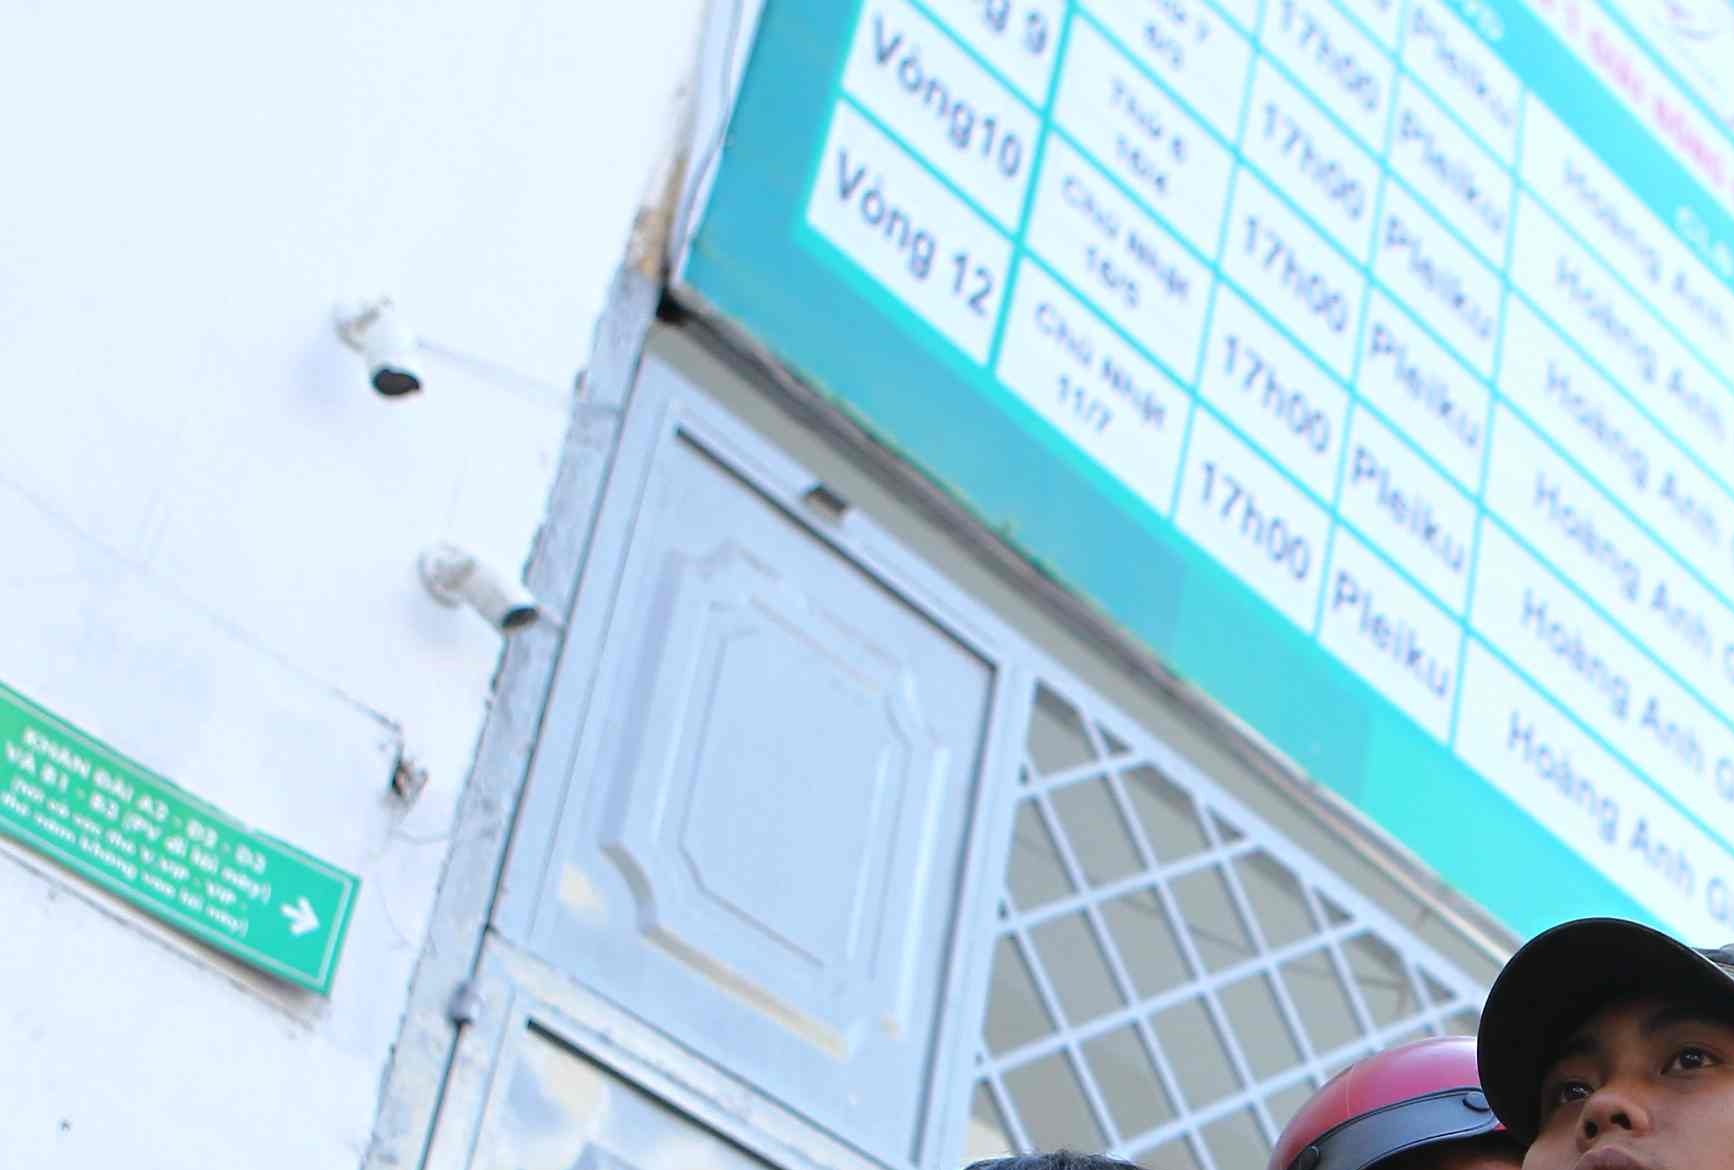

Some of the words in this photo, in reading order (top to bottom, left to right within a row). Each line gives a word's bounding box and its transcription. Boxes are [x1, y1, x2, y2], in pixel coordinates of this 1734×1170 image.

[872, 14, 1021, 177] Vòng10
[1022, 0, 1054, 71] 9
[1263, 101, 1364, 220] 17h00
[1396, 108, 1505, 232] Pleiku
[835, 147, 935, 279] Vòng
[951, 249, 1002, 330] 12
[1244, 214, 1348, 333] 17h00
[1380, 214, 1494, 338] Pleiku
[1033, 301, 1093, 367] Chủ
[1223, 334, 1330, 453] 17h00
[1367, 321, 1480, 447] Pleiku
[1556, 256, 1657, 384] Hoàng
[1664, 366, 1724, 430] Anh
[1056, 372, 1113, 433] 11/7
[1545, 361, 1649, 489] Hoàng
[1657, 468, 1719, 544] Anh
[1200, 460, 1310, 580] 17h00
[1349, 444, 1466, 572] Pleiku
[1534, 470, 1640, 602] Hoàng
[1649, 581, 1712, 656] Anh
[1331, 570, 1451, 701] Pleiku
[1520, 587, 1630, 720] Hoàng
[1637, 695, 1704, 772] Anh
[1507, 710, 1619, 844] Hoàng
[1629, 815, 1695, 894] Anh
